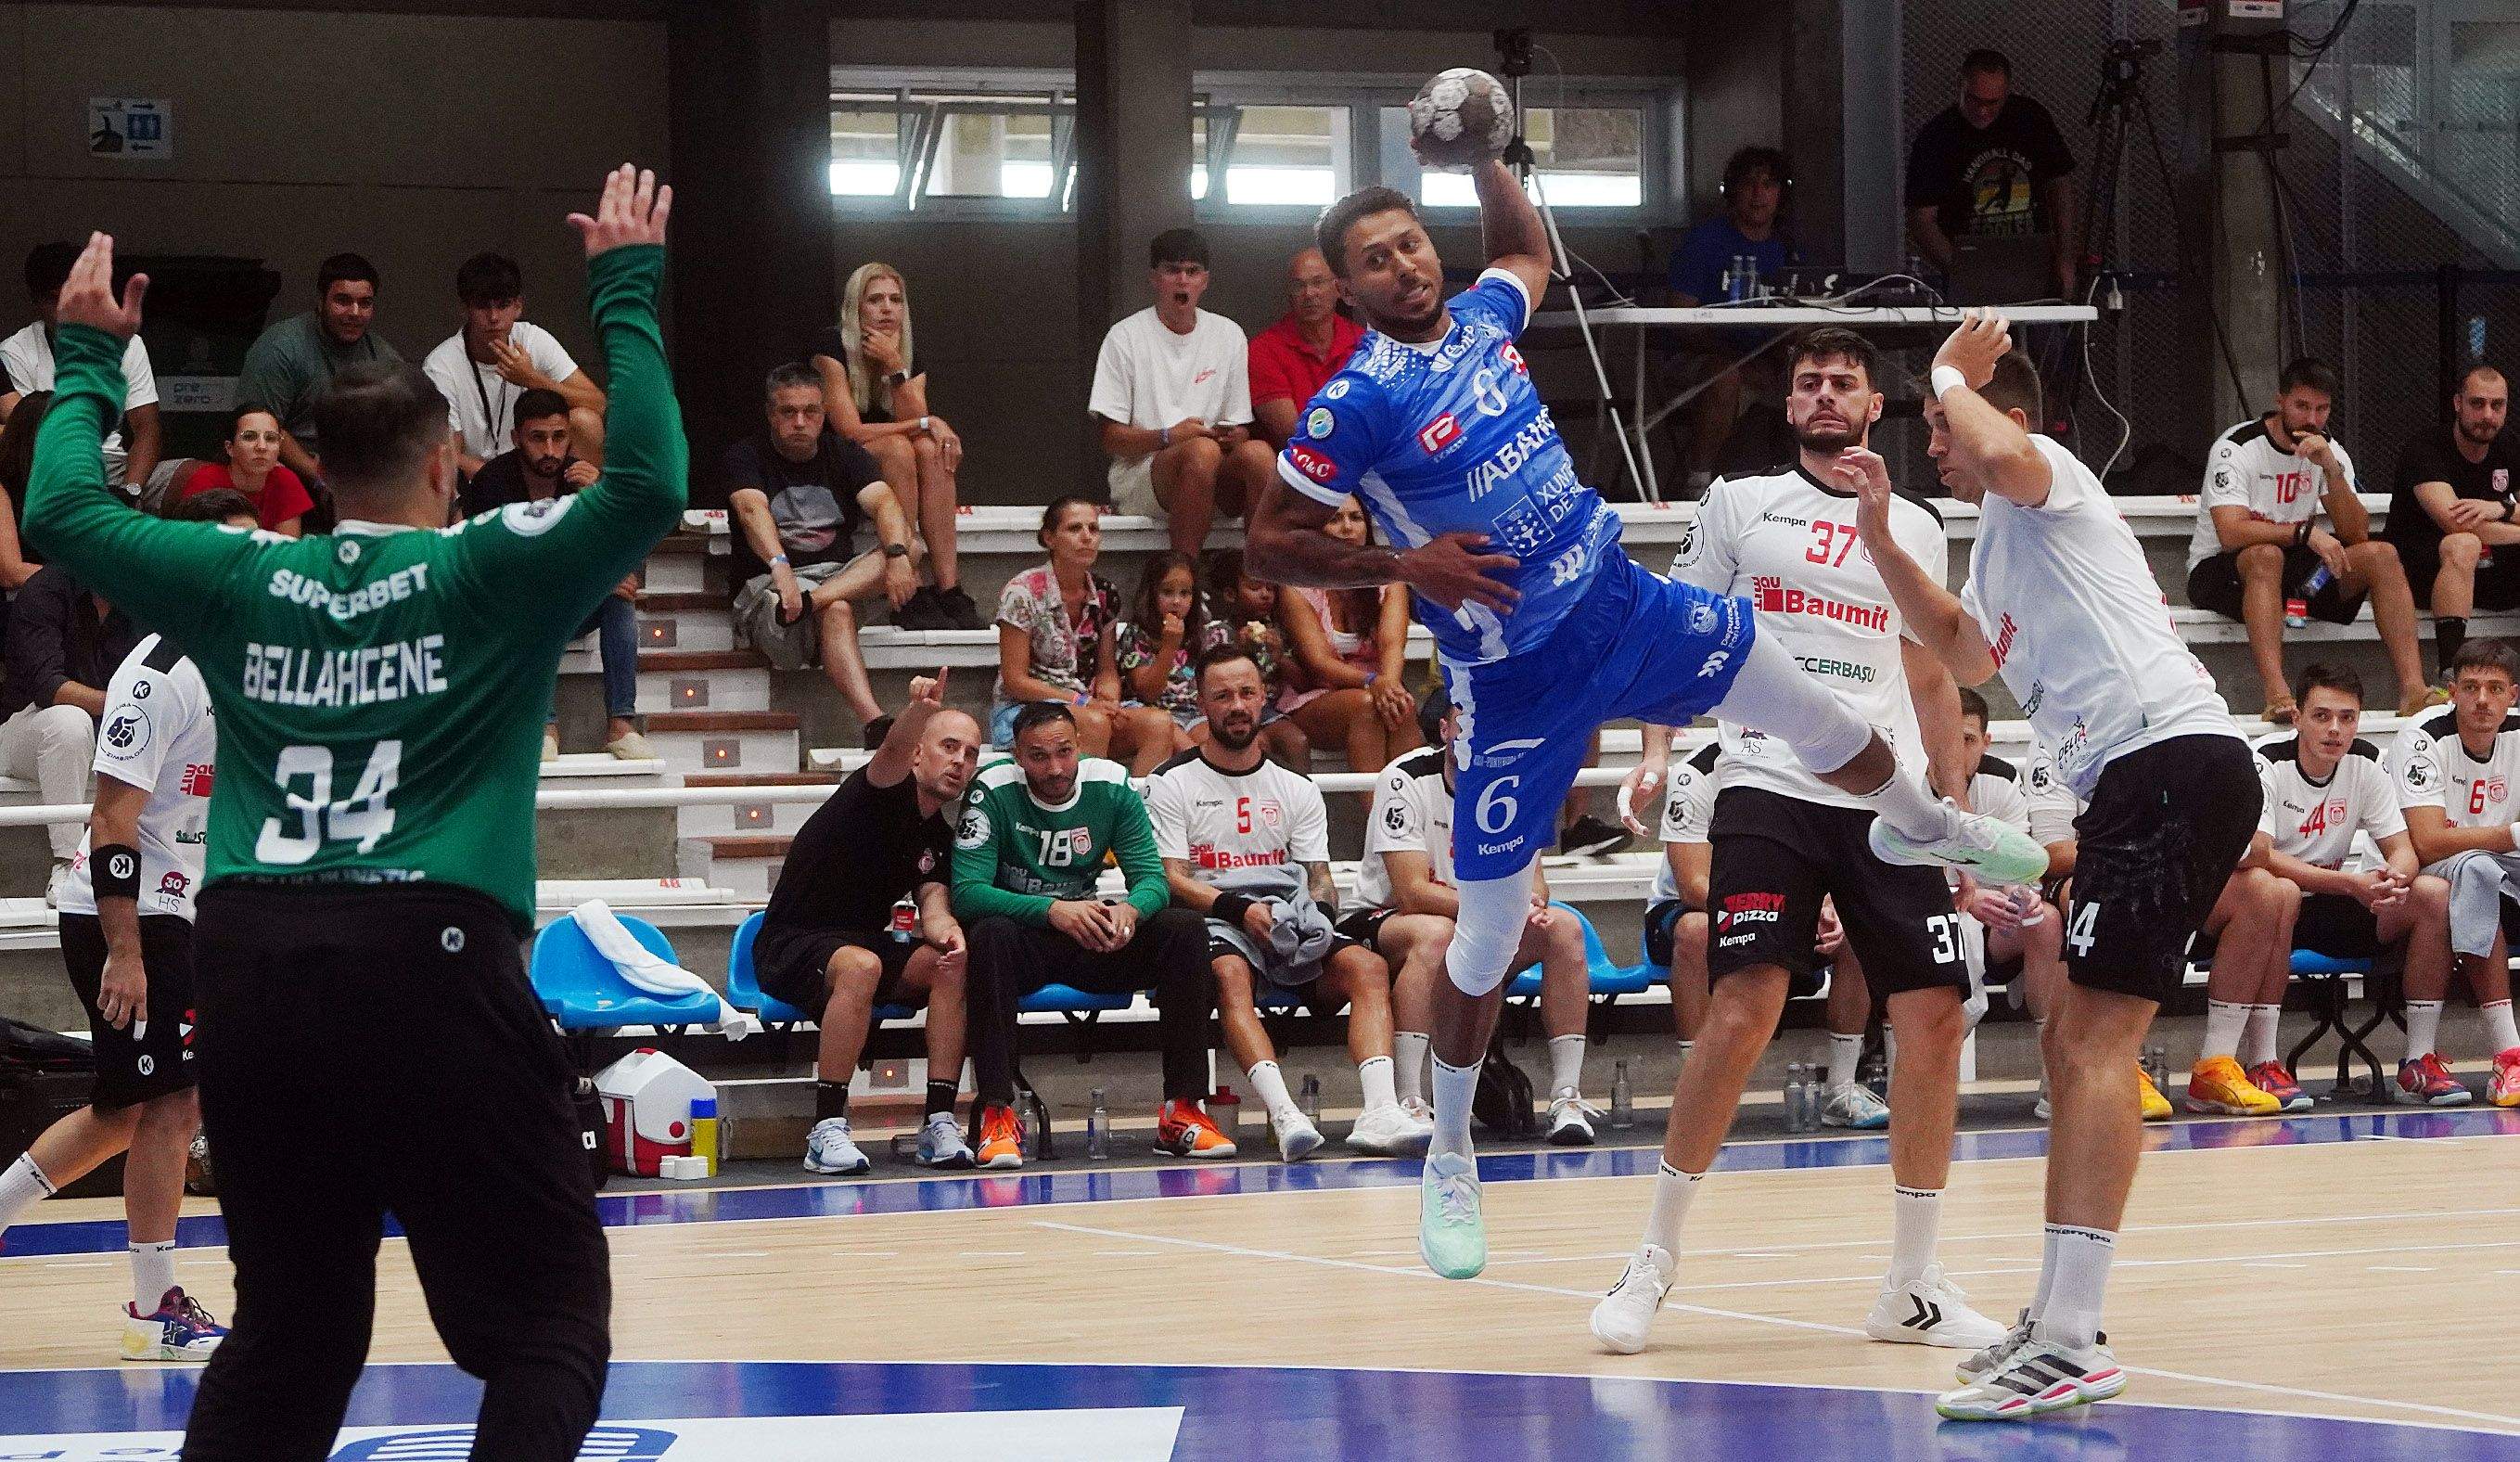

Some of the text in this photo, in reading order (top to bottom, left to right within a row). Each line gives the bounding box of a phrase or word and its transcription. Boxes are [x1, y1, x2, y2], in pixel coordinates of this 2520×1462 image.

[2276, 472, 2300, 504] 10
[1762, 512, 1808, 527] Kempa
[1805, 519, 1859, 569] 37
[268, 562, 429, 621] SUPERBET
[1785, 588, 1889, 634] Baumit
[242, 633, 449, 709] BELLAHCENE
[255, 739, 403, 866] 34
[1475, 775, 1520, 834] 6
[2468, 779, 2486, 814] 6
[1237, 796, 1251, 834] 5
[1038, 829, 1072, 867] 18
[1218, 848, 1286, 870] Baumit
[1477, 834, 1524, 856] Kempa
[164, 875, 185, 890] 30
[158, 895, 181, 913] HS
[1733, 909, 1779, 926] pizza
[1719, 932, 1756, 948] Kempa
[1895, 1188, 1937, 1199] empa
[2060, 1226, 2112, 1244] empa
